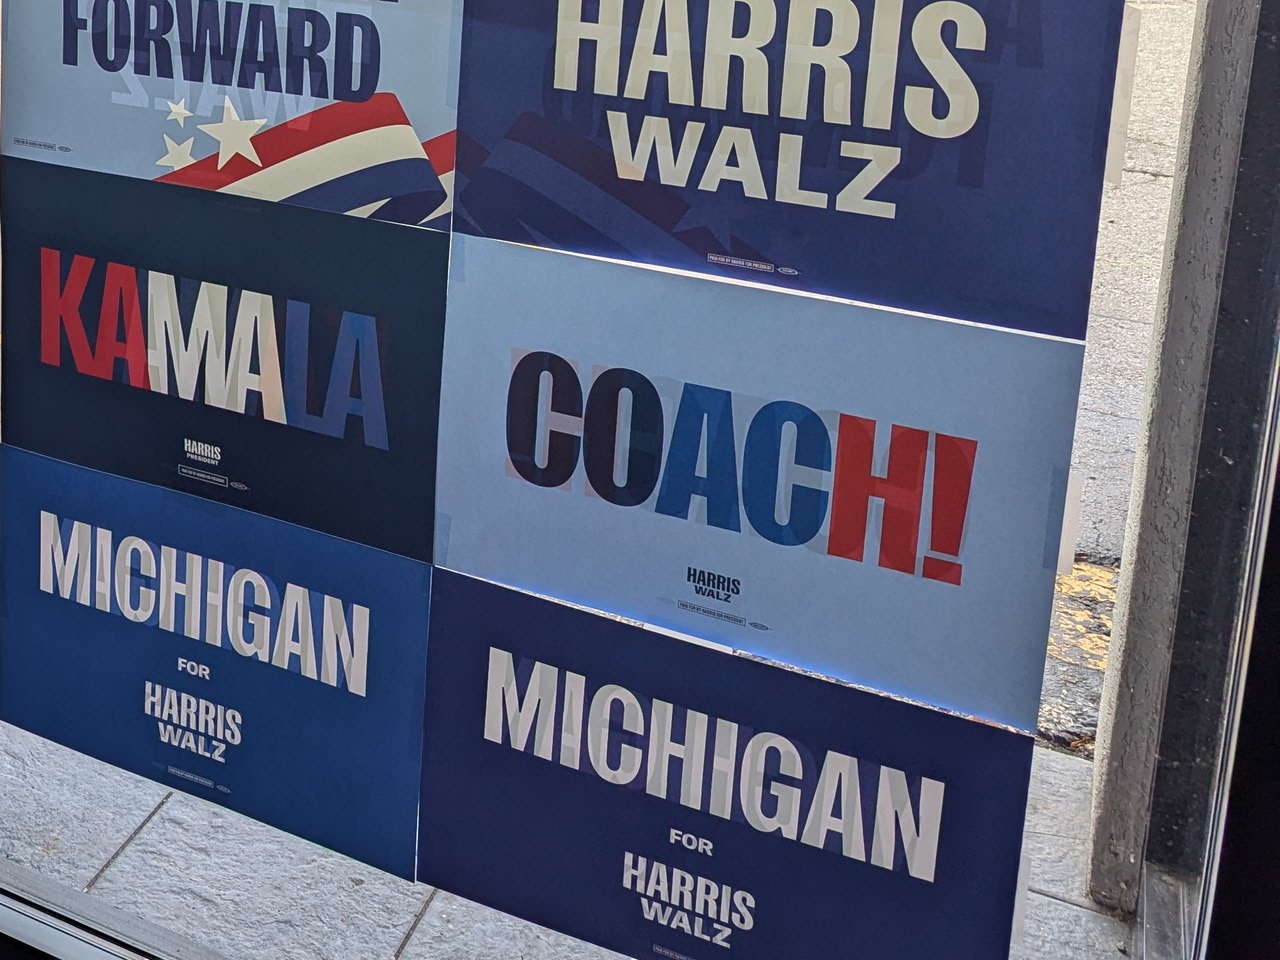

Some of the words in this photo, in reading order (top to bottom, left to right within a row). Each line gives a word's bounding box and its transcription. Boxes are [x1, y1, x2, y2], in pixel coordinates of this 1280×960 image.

[605, 109, 902, 220] WALZ
[40, 246, 390, 451] KAMALA
[184, 437, 221, 460] HARRIS
[186, 452, 219, 466] PRESIDENT
[505, 350, 979, 587] COACH!
[39, 509, 370, 698] MICHIGAN
[686, 566, 741, 595] HARRIS
[694, 584, 732, 604] WALZ
[177, 656, 211, 681] FOR
[144, 680, 243, 746] HARRIS
[157, 720, 227, 764] WALZ
[482, 645, 946, 884] MICHIGAN
[669, 827, 714, 858] FOR
[622, 851, 756, 931] HARRIS
[640, 896, 732, 950] WALZ
